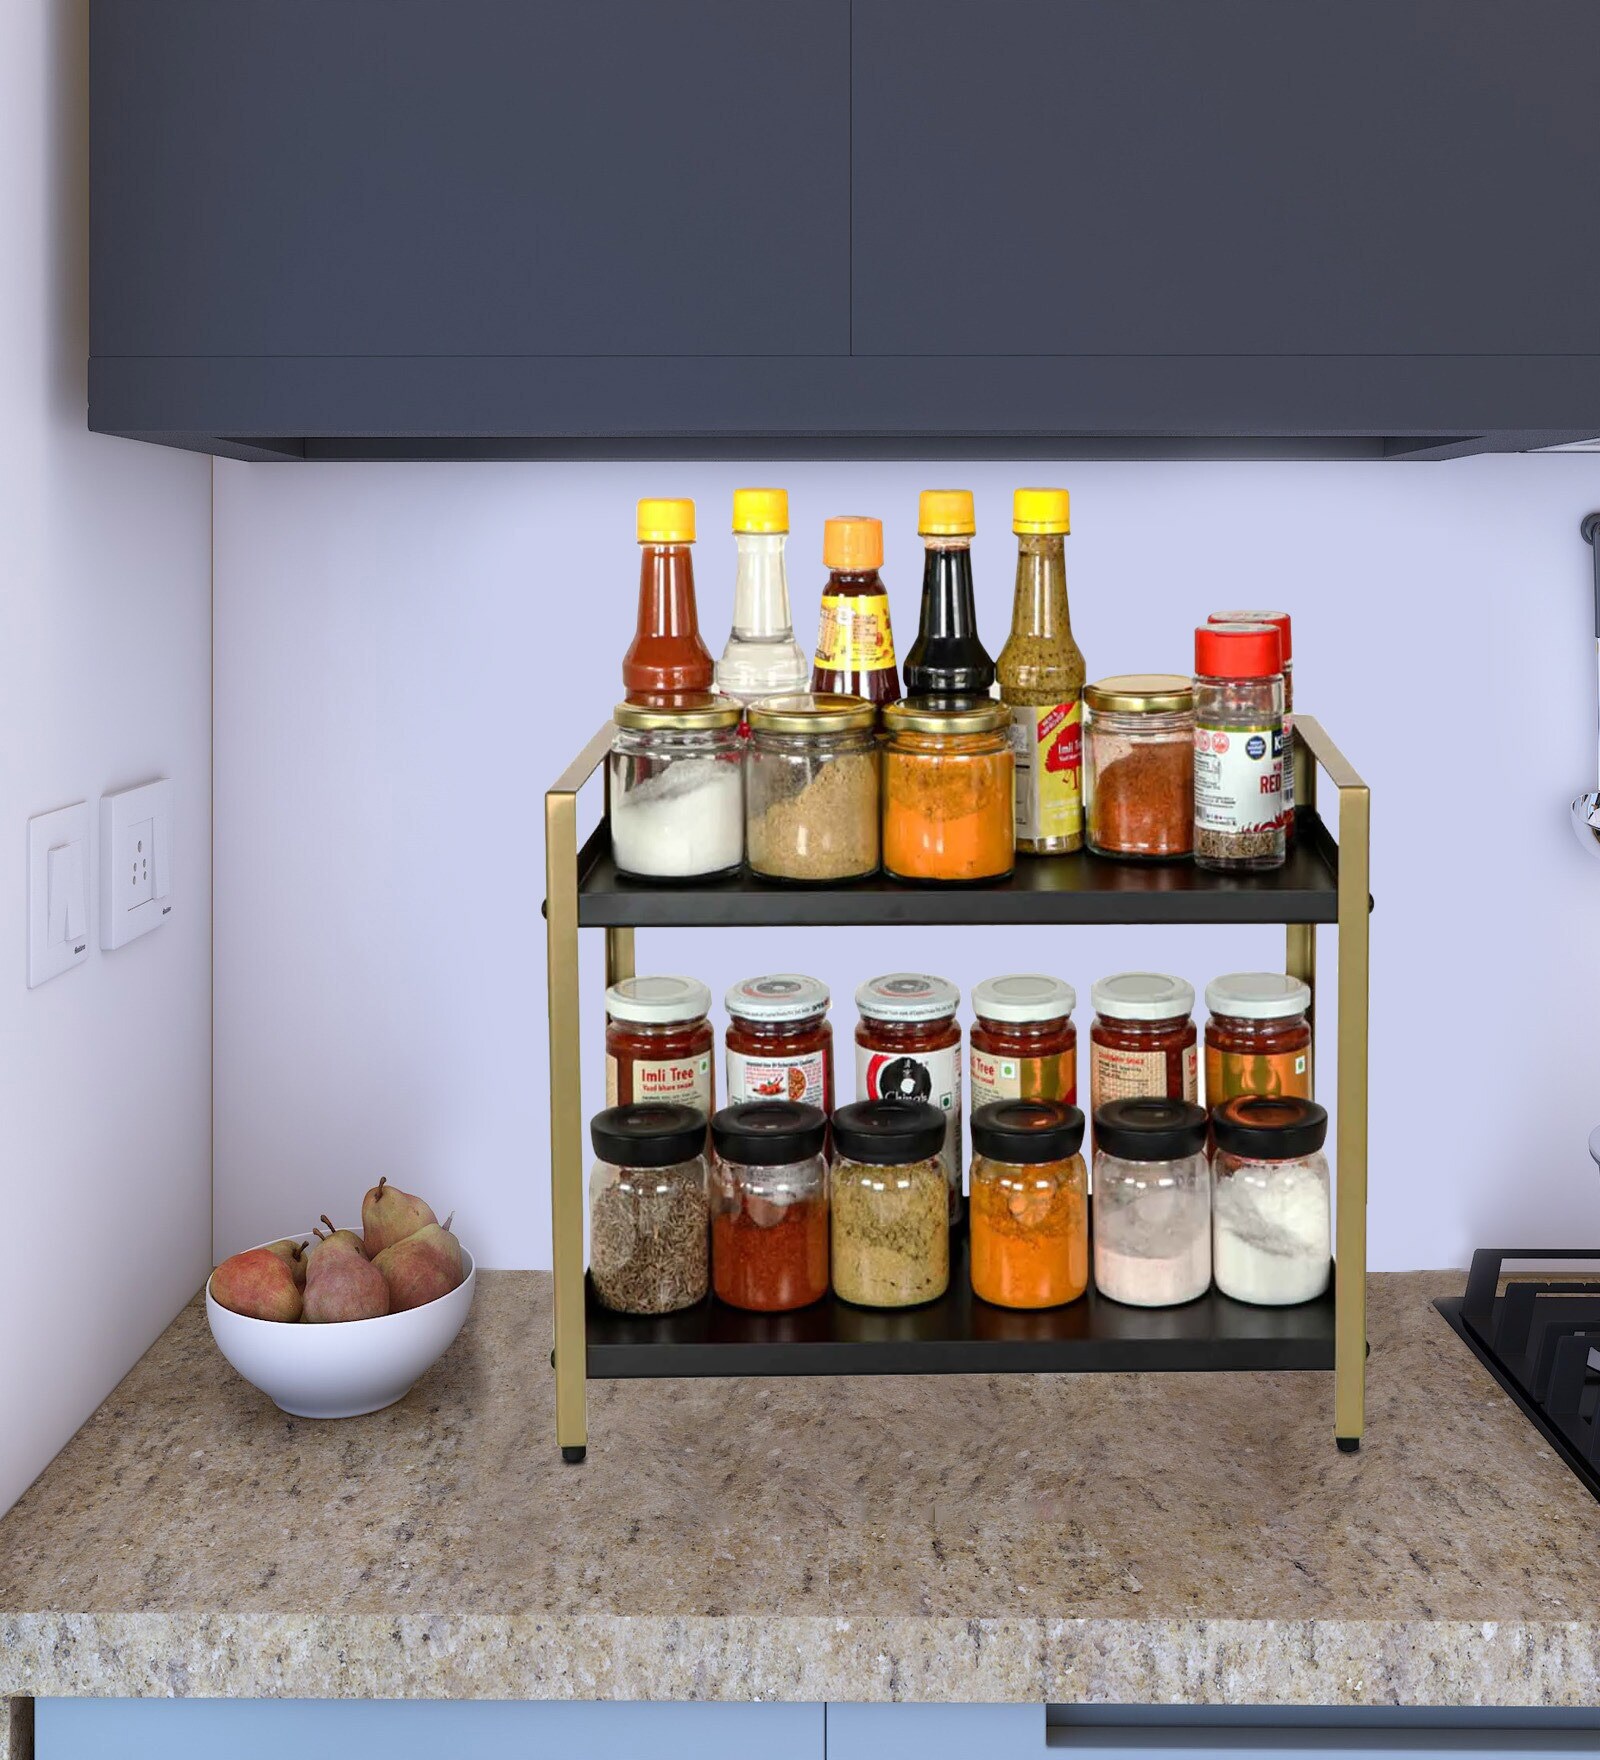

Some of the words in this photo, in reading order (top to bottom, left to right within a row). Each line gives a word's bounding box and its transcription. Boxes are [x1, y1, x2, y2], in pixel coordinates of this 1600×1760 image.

[1260, 773, 1281, 794] RED
[642, 1068, 666, 1082] Imli
[670, 1066, 694, 1081] Tree
